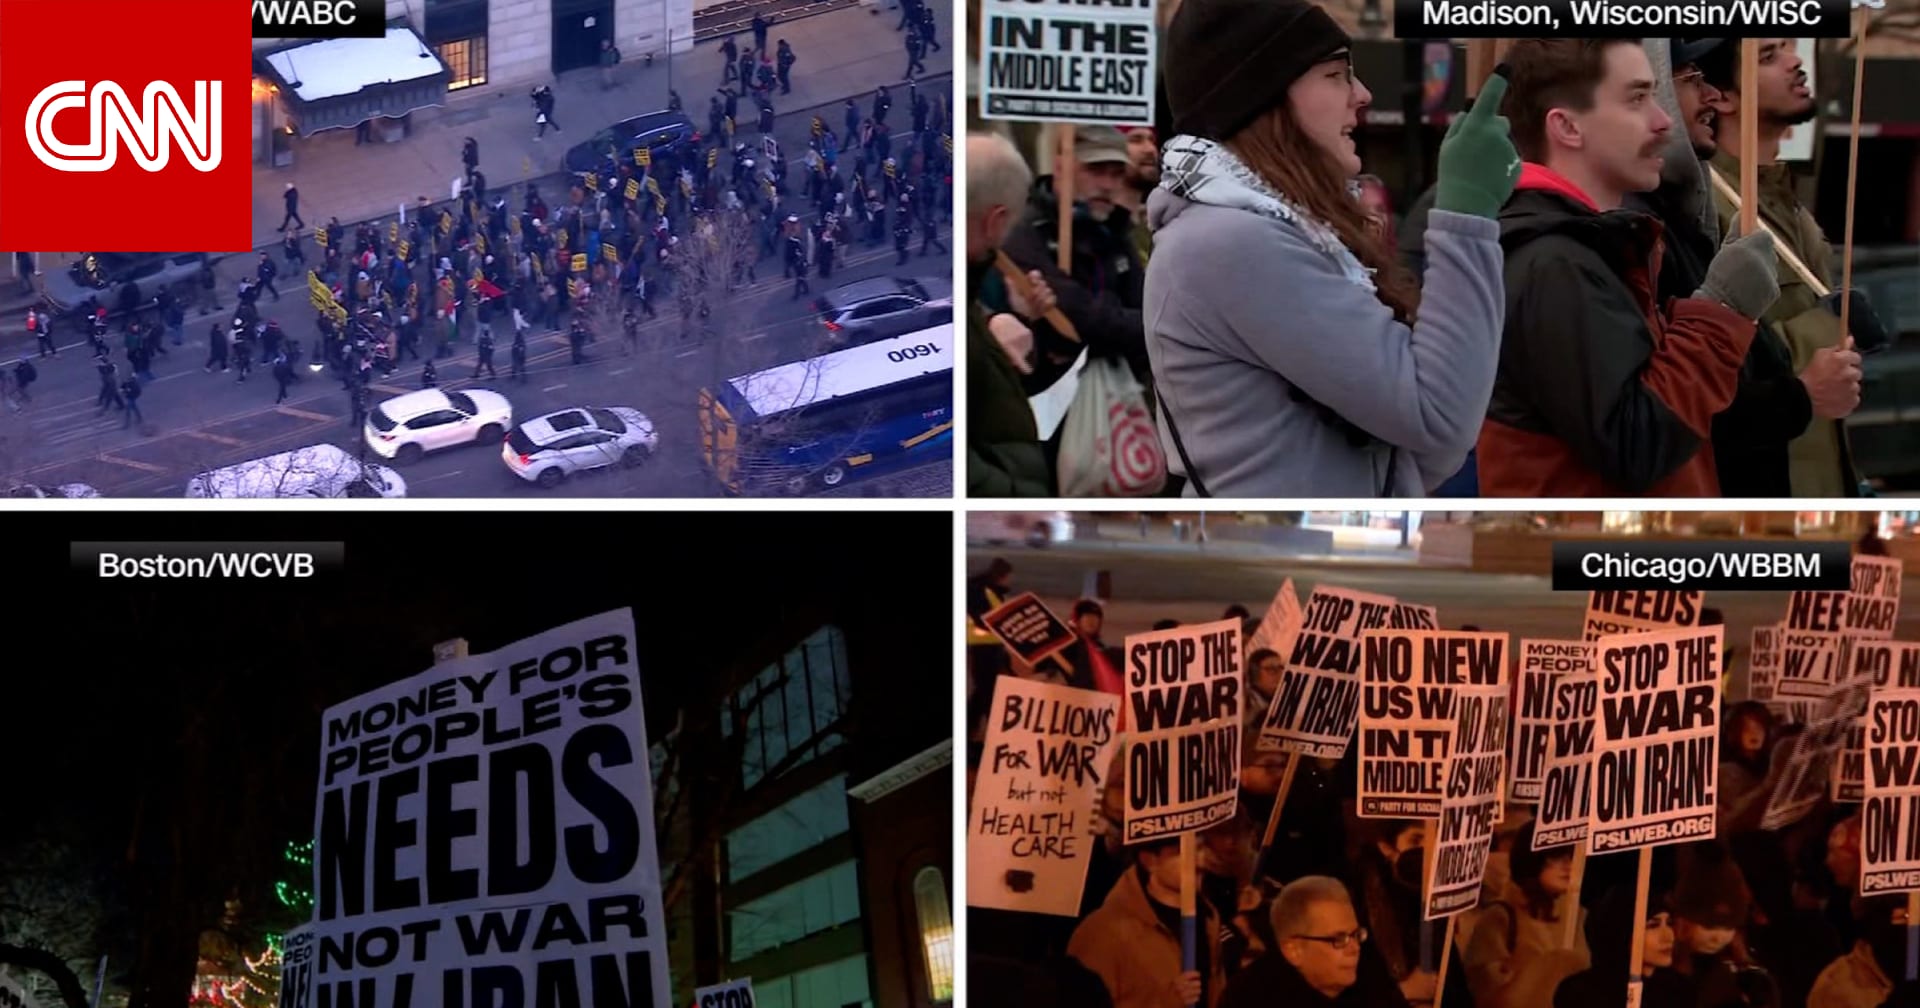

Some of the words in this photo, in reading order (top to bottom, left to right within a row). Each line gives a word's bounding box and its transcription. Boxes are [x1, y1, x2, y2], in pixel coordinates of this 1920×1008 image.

[991, 16, 1042, 49] IN
[1050, 20, 1148, 55] THE
[989, 52, 1082, 92] MIDDLE
[1089, 58, 1147, 96] EAST
[887, 342, 942, 363] 1600
[1850, 562, 1882, 596] STOP
[1302, 592, 1355, 634] STOP
[1588, 619, 1632, 634] NOT
[1845, 597, 1895, 631] WAR
[1131, 638, 1195, 688] STOP
[1201, 629, 1238, 678] THE
[1365, 636, 1412, 683] NO
[1423, 637, 1503, 685] NEW
[1527, 643, 1590, 657] MONEY
[1787, 634, 1828, 648] NOT
[1603, 642, 1669, 694] STOP
[1675, 635, 1716, 685] THE
[1784, 648, 1818, 678] W/
[1853, 646, 1892, 687] NO
[327, 670, 498, 747] MONEY
[509, 634, 629, 696] FOR
[1130, 676, 1238, 733] WAR
[1364, 685, 1413, 720] US
[1556, 680, 1597, 721] STO
[324, 674, 632, 786] PEOPLE'S
[1001, 694, 1114, 747] BILLIONS
[1455, 696, 1482, 754] NO
[1602, 685, 1715, 741] WAR
[1871, 700, 1920, 743] STO
[1364, 729, 1409, 757] IN
[1554, 720, 1597, 758] W
[993, 744, 1031, 774] FOR
[1037, 739, 1100, 788] WAR
[1130, 738, 1169, 811] ON
[1179, 724, 1238, 804] IRAN!
[1364, 760, 1442, 794] MIDDLE
[1446, 756, 1473, 799] US
[1596, 748, 1637, 823] ON
[1641, 736, 1714, 814] IRAN!
[1870, 746, 1920, 788] W
[1007, 777, 1037, 801] but
[1040, 786, 1067, 804] not
[1380, 801, 1401, 812] PARTY
[1402, 801, 1417, 812] FOR
[1542, 764, 1579, 825] ON
[319, 724, 640, 921] NEEDS
[980, 807, 1075, 836] HEALTH
[1129, 801, 1235, 837] PSLWEB.ORG
[1441, 805, 1465, 843] IN
[1465, 801, 1495, 839] THE
[1594, 815, 1712, 850] PSLWEB.ORG
[1866, 796, 1900, 864] ON
[1906, 795, 1920, 862] I
[1011, 836, 1077, 859] CARE
[319, 919, 441, 974] NOT
[456, 894, 648, 956] WAR
